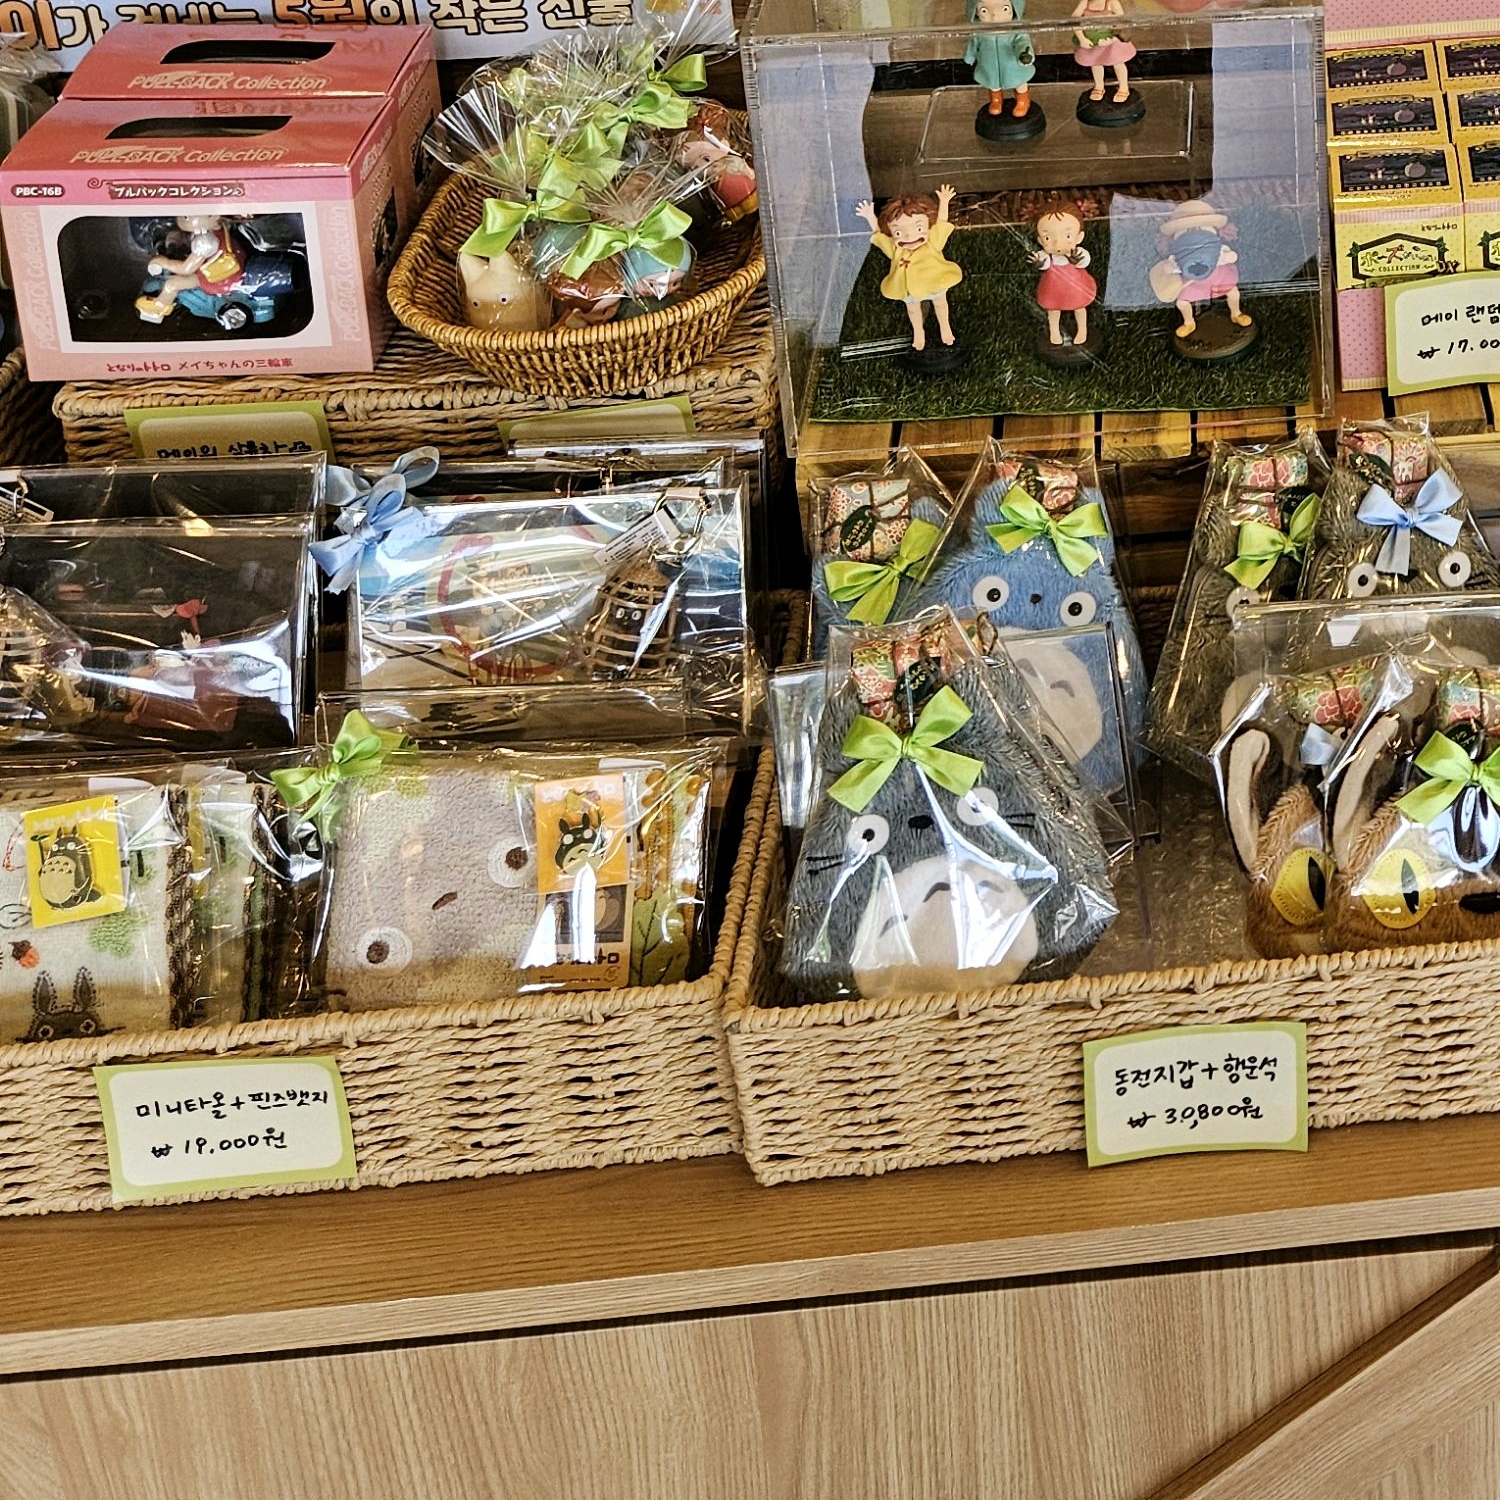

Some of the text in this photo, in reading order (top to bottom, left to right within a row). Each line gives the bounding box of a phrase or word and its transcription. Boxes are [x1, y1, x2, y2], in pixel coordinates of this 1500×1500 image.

[233, 76, 326, 90] Collection
[183, 147, 284, 163] Collection
[15, 186, 63, 197] PBC-16B
[1378, 263, 1421, 272] COLLECTION
[1436, 260, 1460, 274] DX
[1421, 308, 1458, 326] 메이
[178, 357, 294, 371] メイちゃんの三輪車
